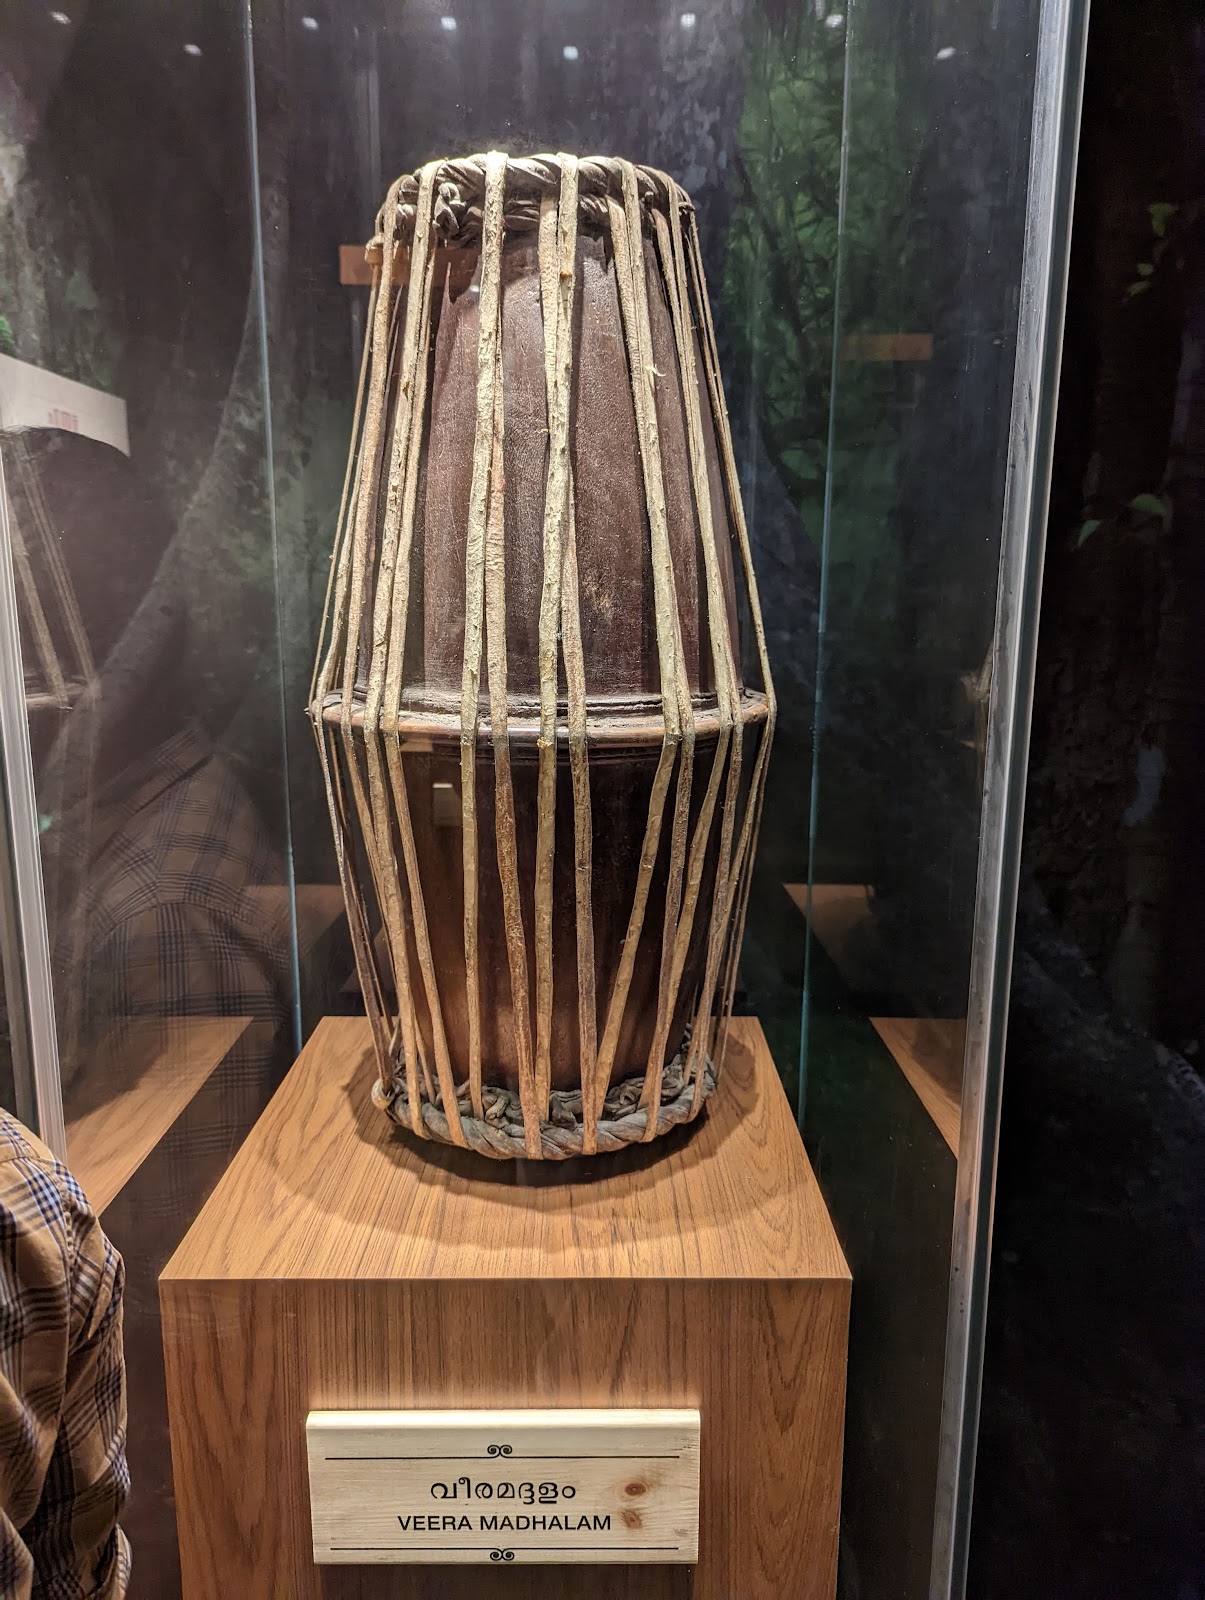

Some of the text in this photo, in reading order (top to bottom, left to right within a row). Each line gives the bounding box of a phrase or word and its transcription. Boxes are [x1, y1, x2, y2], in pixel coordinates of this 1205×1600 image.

[430, 1476, 577, 1505] വീരമദ്ദളം
[397, 1515, 611, 1531] VEERA MADHALAM
